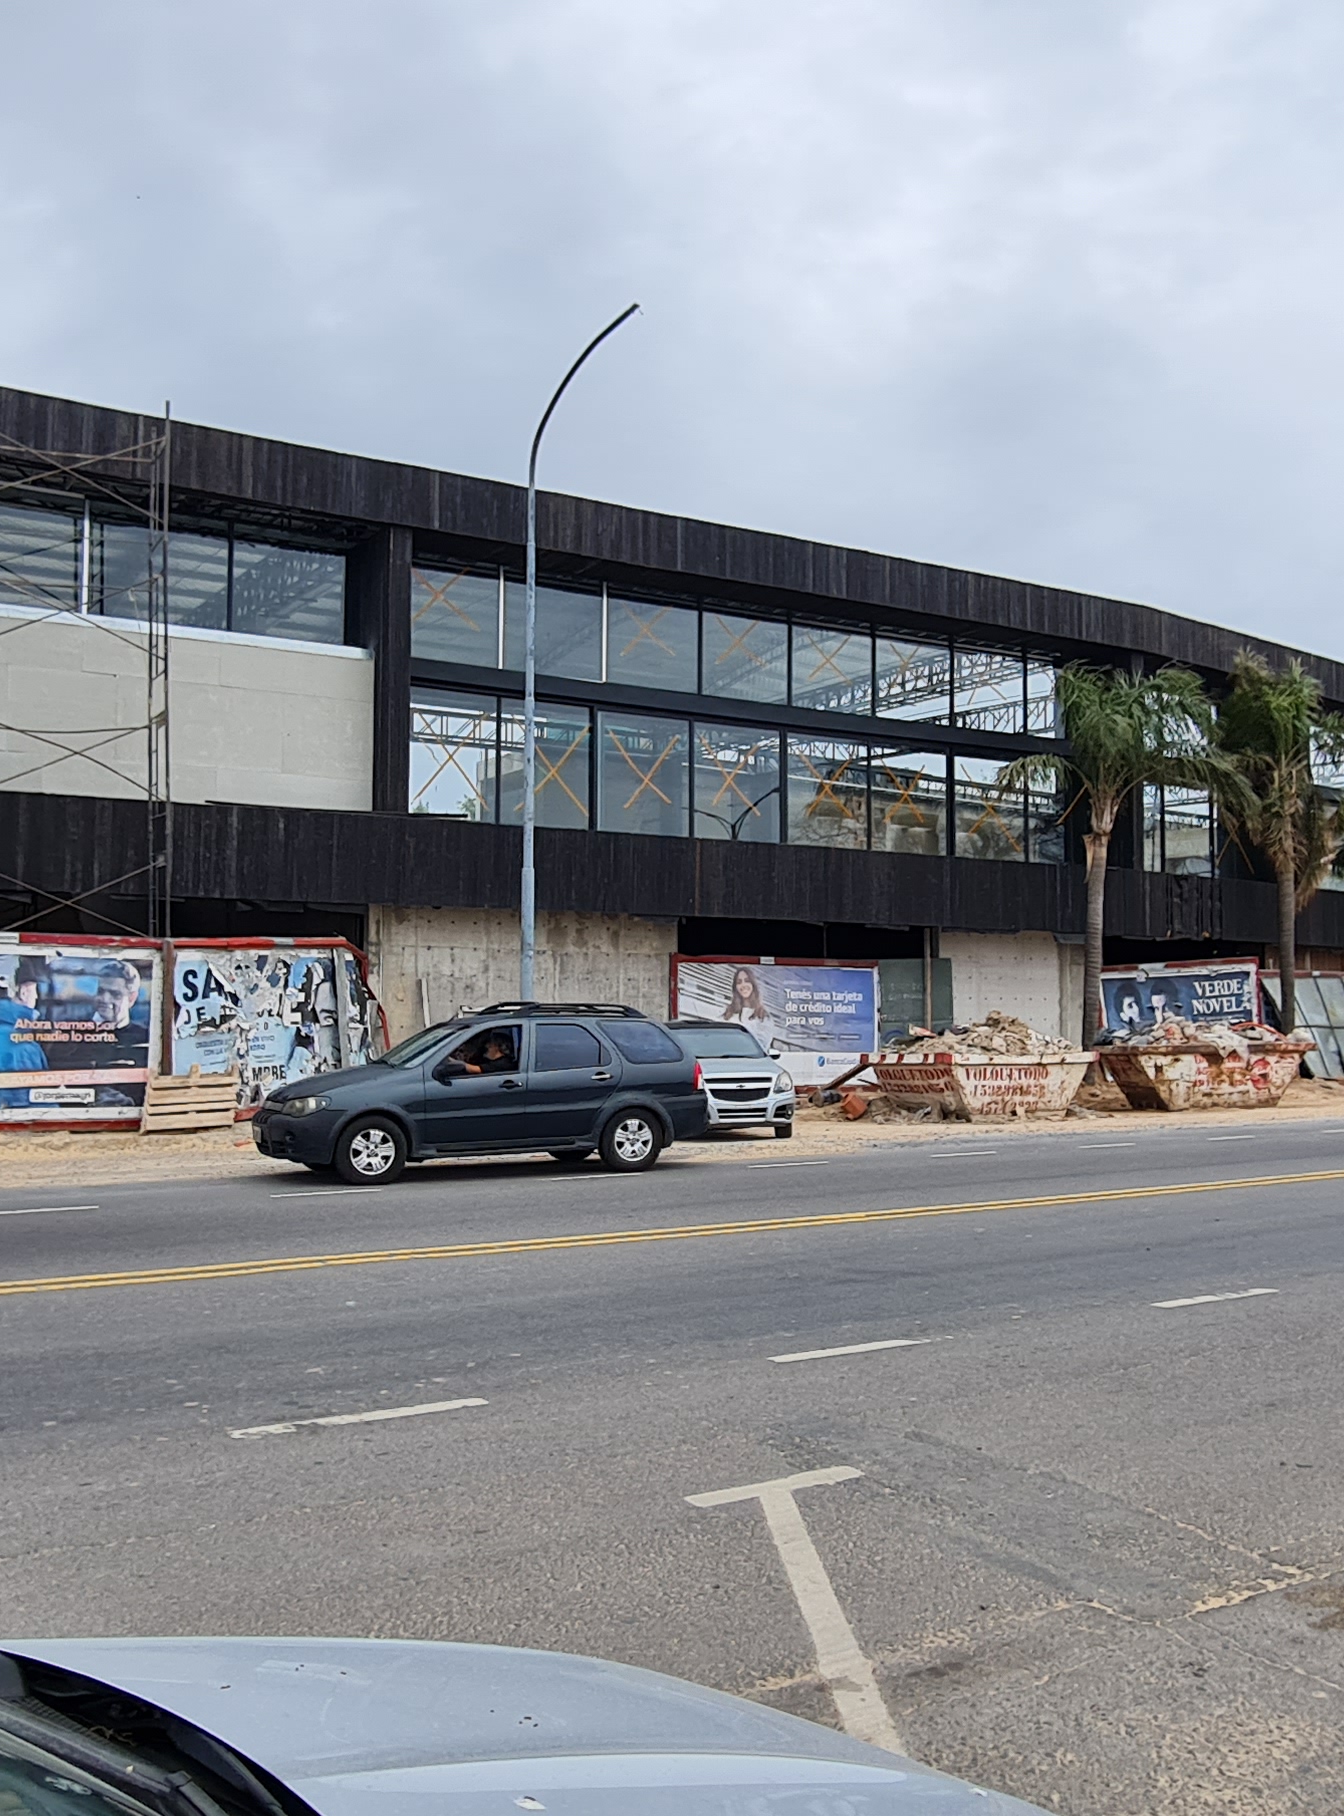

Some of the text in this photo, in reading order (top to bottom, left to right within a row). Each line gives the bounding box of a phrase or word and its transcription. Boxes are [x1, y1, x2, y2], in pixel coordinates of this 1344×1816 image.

[1192, 978, 1243, 997] VERDE
[813, 991, 831, 1000] una
[785, 1002, 797, 1012] de
[1192, 995, 1251, 1015] NOVELA
[14, 1019, 52, 1030] Ahora
[54, 1021, 94, 1030] vamos
[785, 1016, 825, 1027] para vos
[10, 1033, 34, 1043] que
[35, 1031, 69, 1042] nadie
[71, 1030, 82, 1042] lo
